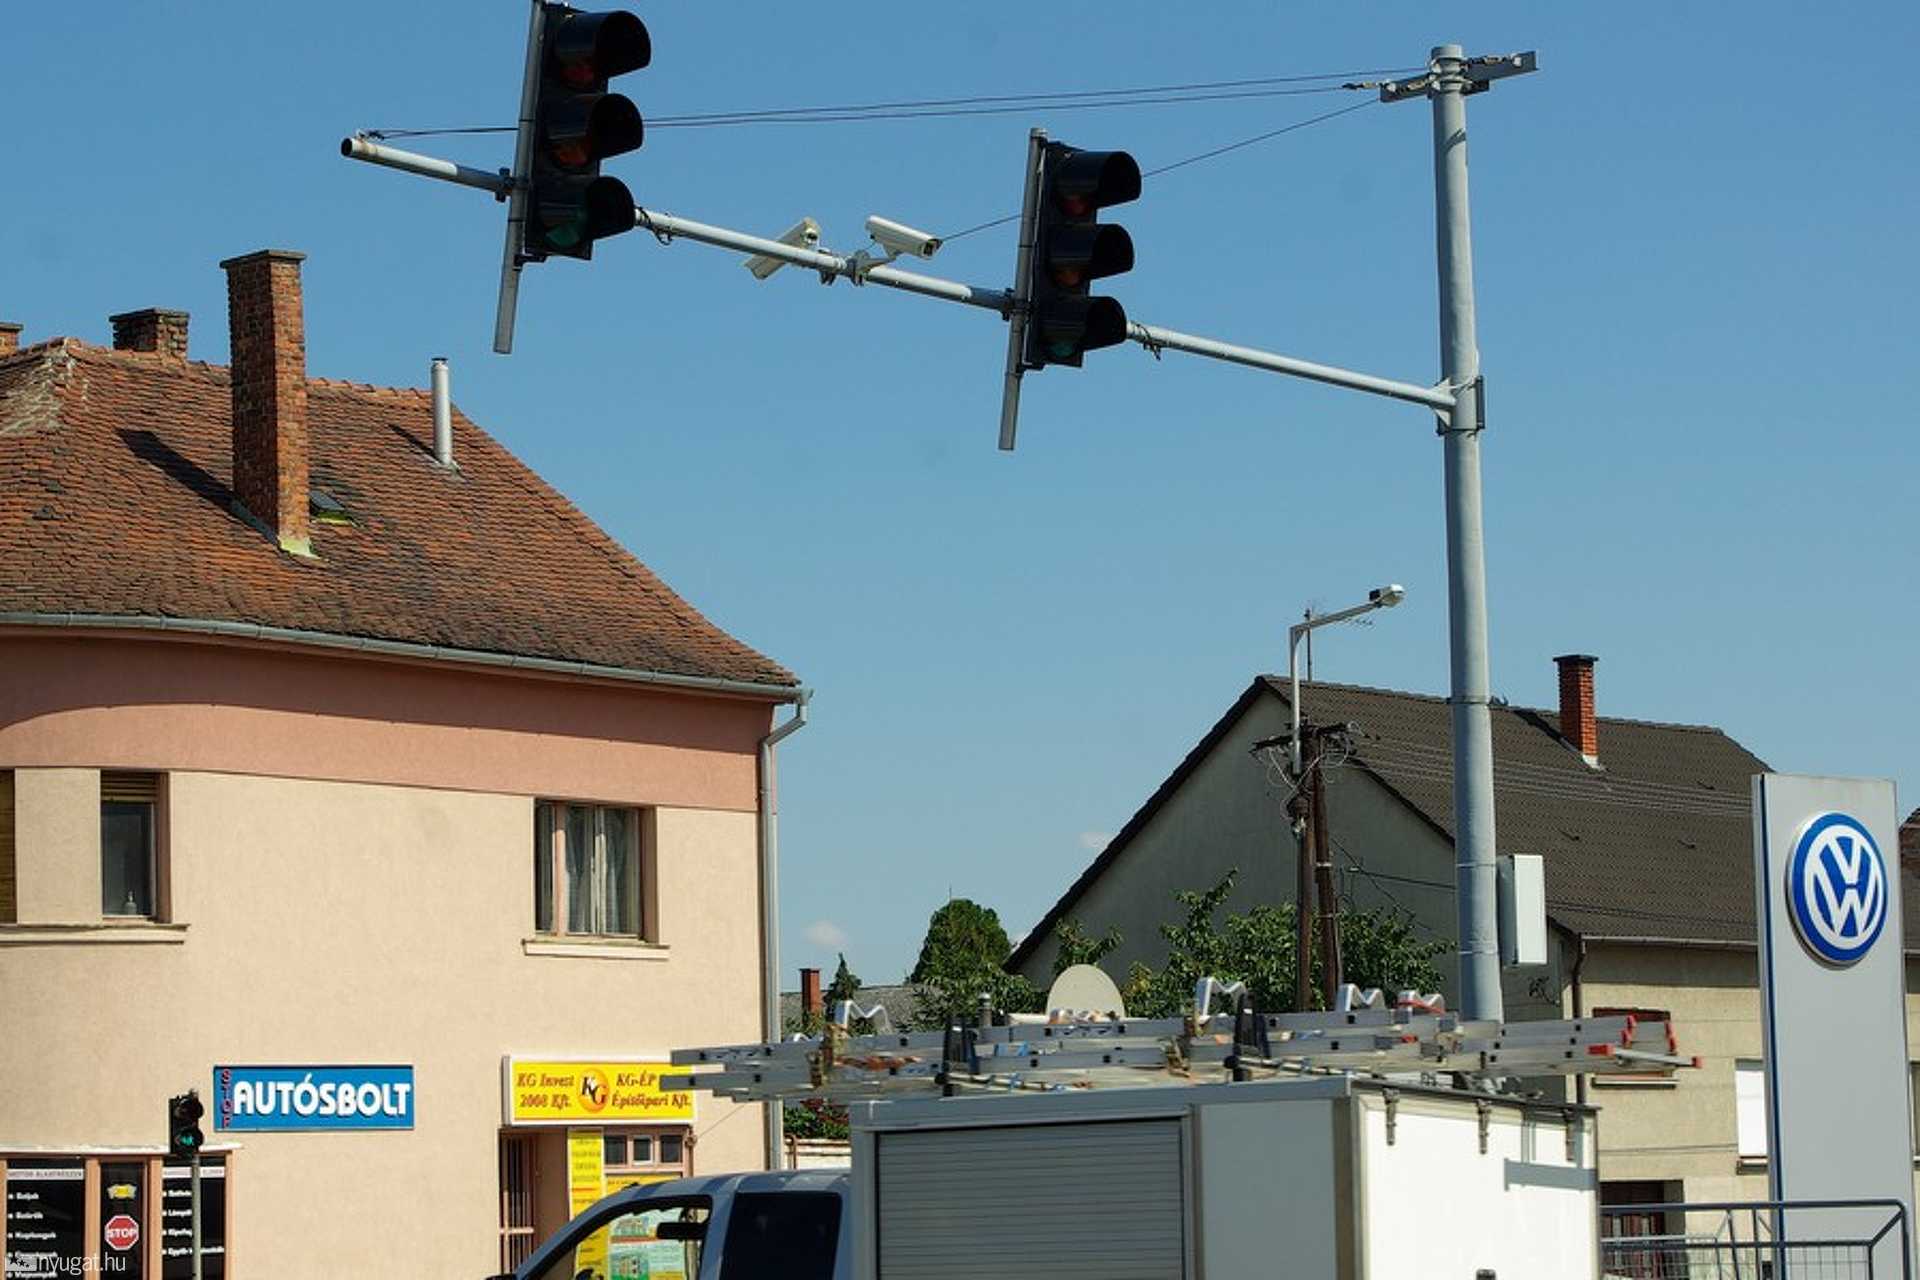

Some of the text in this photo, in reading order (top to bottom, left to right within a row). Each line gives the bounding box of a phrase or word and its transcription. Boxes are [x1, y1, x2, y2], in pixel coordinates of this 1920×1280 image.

[517, 1072, 575, 1088] KG Invest
[616, 1070, 657, 1087] KG-ÉP
[233, 1072, 411, 1116] AUTÓSBOLT
[520, 1094, 571, 1110] 2008 Kft.
[671, 1093, 691, 1110] Kft.
[105, 1228, 139, 1238] STOP
